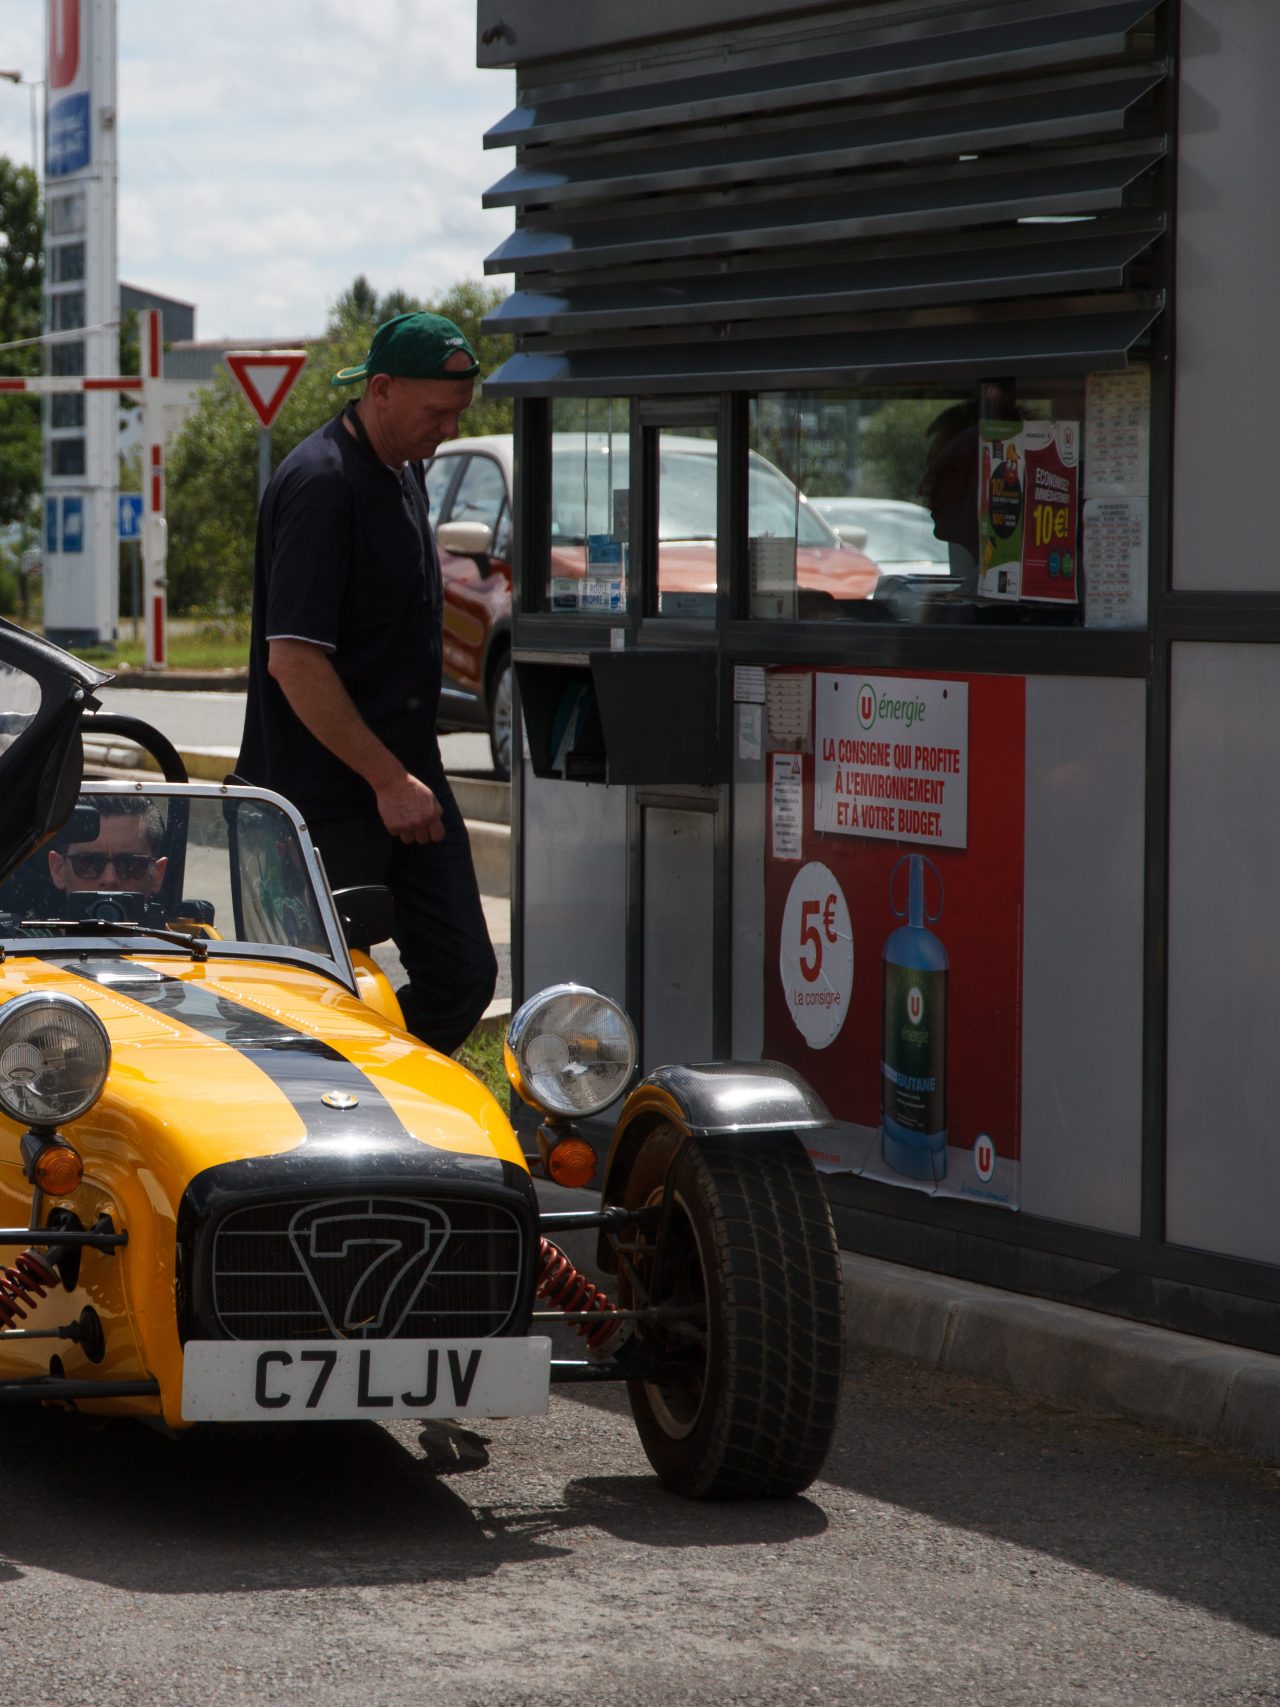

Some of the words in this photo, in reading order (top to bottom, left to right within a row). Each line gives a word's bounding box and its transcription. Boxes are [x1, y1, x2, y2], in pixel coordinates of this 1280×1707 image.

[862, 697, 872, 720] U
[879, 692, 926, 728] énergie
[823, 737, 836, 762] LA
[838, 738, 891, 767] CONSIGNE
[893, 744, 912, 770] QUI
[915, 745, 960, 774] PROFITE
[835, 764, 843, 794] À
[846, 771, 945, 805] L'ENVIRONNEMENT
[837, 801, 849, 827] ET
[852, 798, 859, 828] À
[861, 803, 895, 832] VOTRE
[898, 807, 942, 837] BUDGET.
[794, 989, 804, 1006] La
[806, 990, 841, 1009] consigne
[911, 996, 920, 1017] U
[901, 1023, 929, 1048] énergie
[897, 1072, 936, 1092] BUTANE
[979, 1146, 991, 1173] U
[255, 1349, 337, 1409] C7
[357, 1349, 482, 1408] LJV
